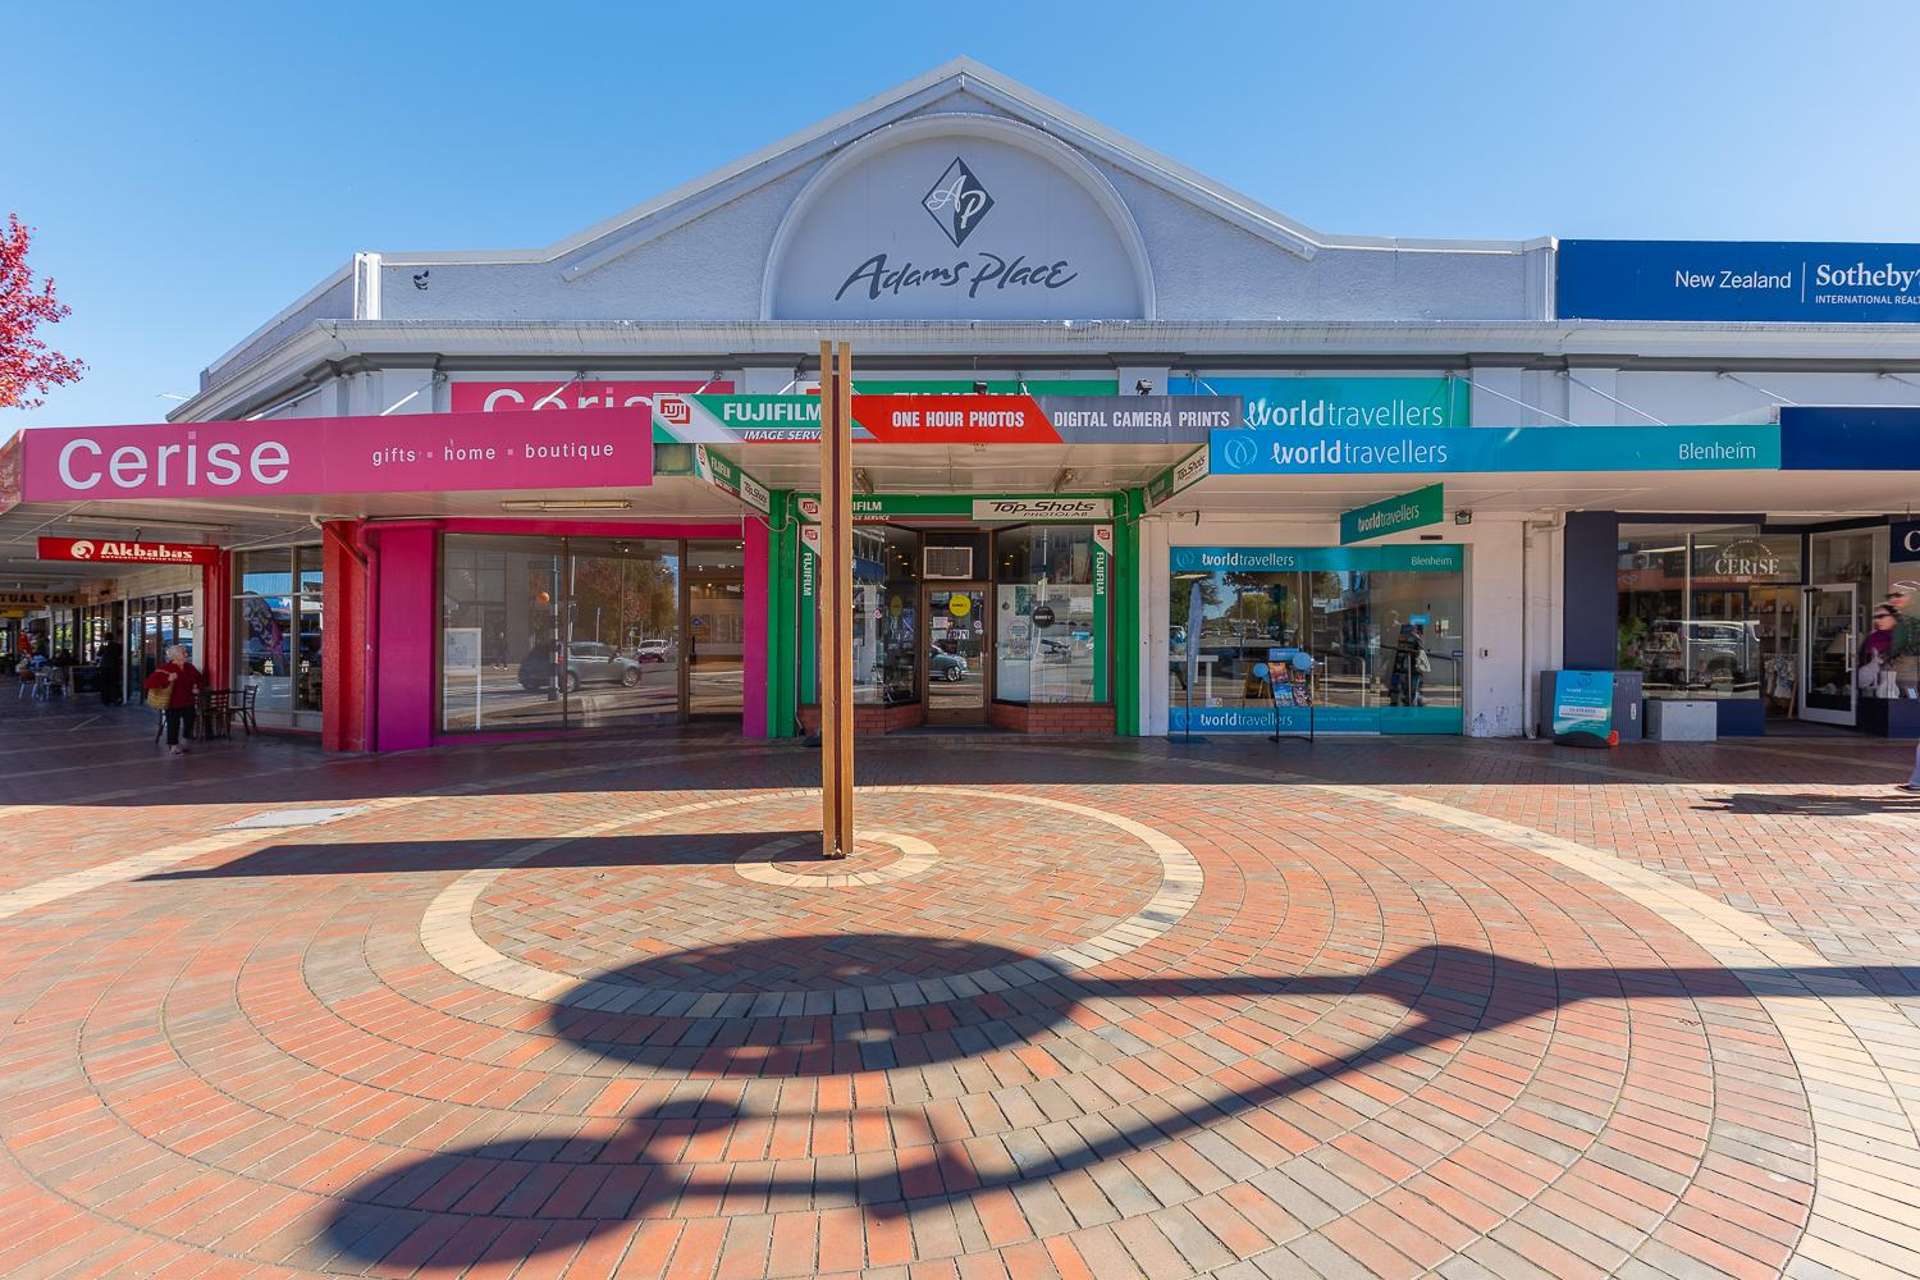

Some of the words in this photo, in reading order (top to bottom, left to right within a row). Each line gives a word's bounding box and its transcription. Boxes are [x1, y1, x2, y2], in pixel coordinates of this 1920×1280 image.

[834, 253, 969, 301] Adams
[970, 252, 1079, 299] Place
[1674, 270, 1715, 289] New
[1719, 270, 1793, 290] Zealand
[1815, 261, 1920, 292] Sotheby
[1815, 294, 1893, 305] INTERNATIONAL
[1894, 294, 1920, 305] REALT
[723, 402, 822, 422] FUJIFILM
[892, 411, 920, 428] ONE
[925, 411, 964, 428] HOUR
[969, 411, 1025, 428] PHOTOS
[1054, 411, 1108, 428] DIGITAL
[1112, 411, 1173, 428] CAMERA
[1178, 411, 1231, 428] PRINTS
[743, 430, 785, 441] IMAGE
[787, 430, 822, 441] SERV
[372, 446, 417, 466] gifts
[444, 440, 496, 461] home
[525, 443, 614, 462] boutique
[1679, 441, 1757, 460] Blenheim
[58, 431, 290, 490] Cerise
[853, 500, 882, 511] IFILM
[989, 500, 1027, 514] Top
[1026, 500, 1097, 512] Shots
[100, 542, 193, 560] Akbabas
[1410, 554, 1453, 567] Blenheim
[0, 592, 36, 603] TUAL
